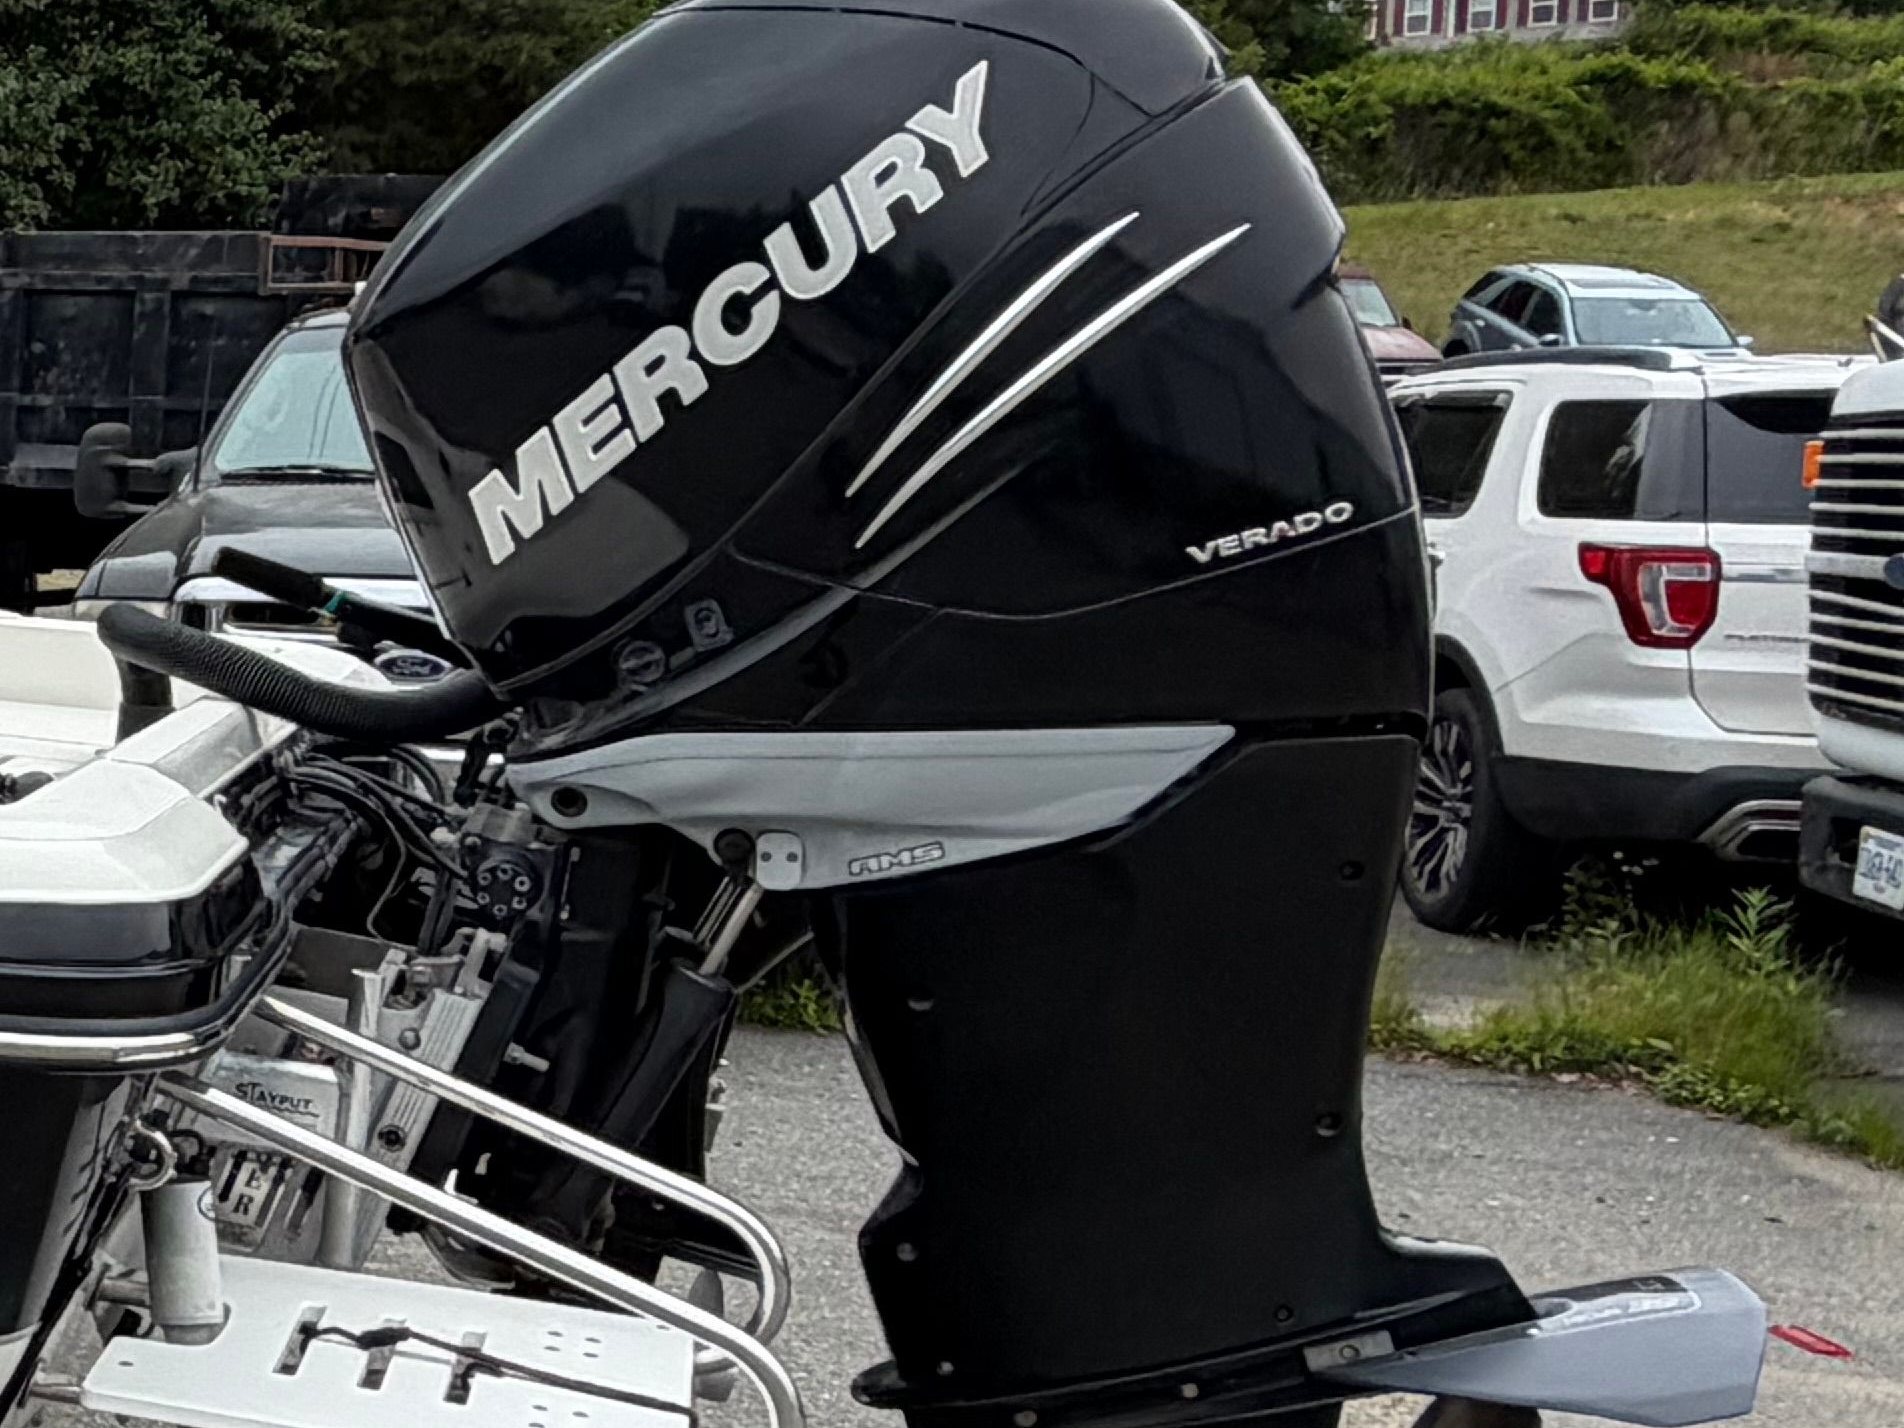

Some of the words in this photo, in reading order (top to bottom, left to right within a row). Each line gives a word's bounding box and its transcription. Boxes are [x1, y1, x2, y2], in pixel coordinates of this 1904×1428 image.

[468, 60, 989, 565] MERCURY
[1184, 501, 1354, 563] VERADO
[848, 841, 945, 877] AMS
